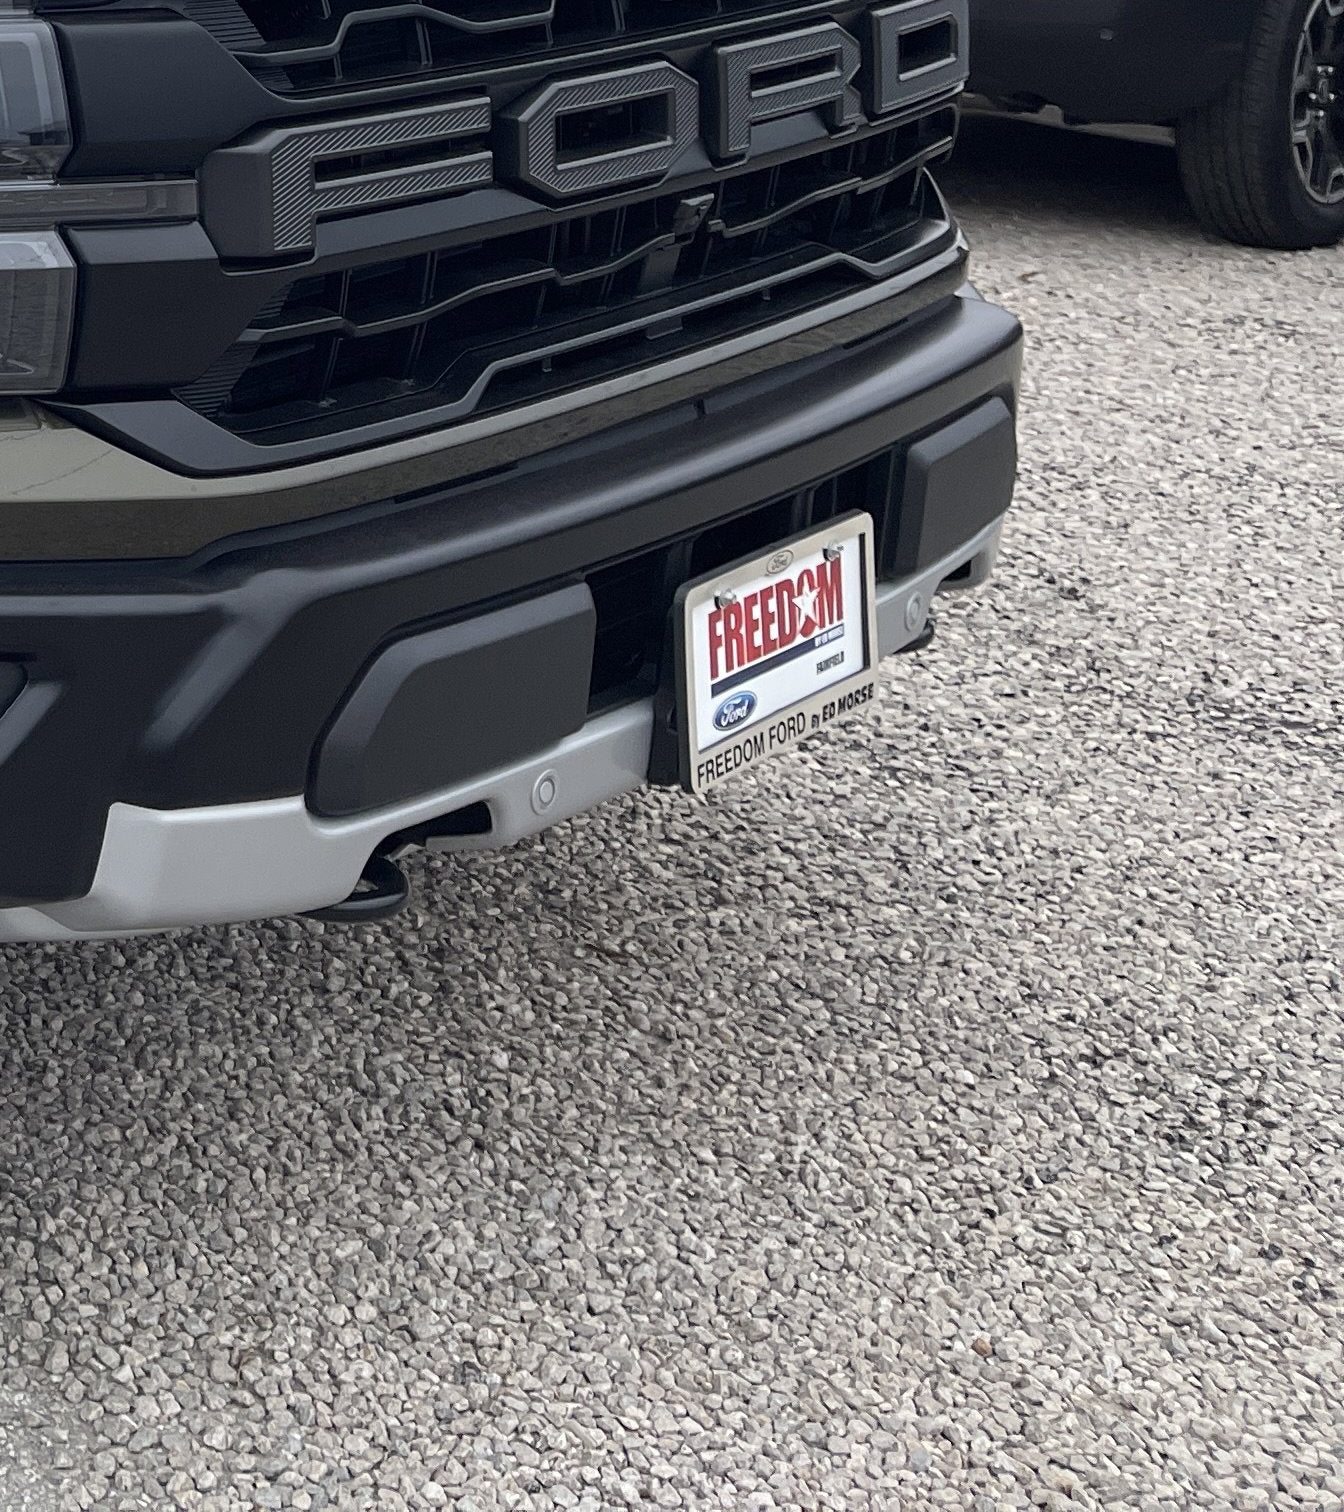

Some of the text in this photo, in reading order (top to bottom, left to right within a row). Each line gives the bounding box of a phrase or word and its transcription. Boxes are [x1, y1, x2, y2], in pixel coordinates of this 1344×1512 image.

[708, 554, 844, 681] FREEDOM
[697, 739, 766, 788] FREEDOM
[769, 711, 807, 750] FORD
[822, 701, 837, 725] ED
[837, 682, 875, 714] MORSE
[720, 697, 749, 728] Ford
